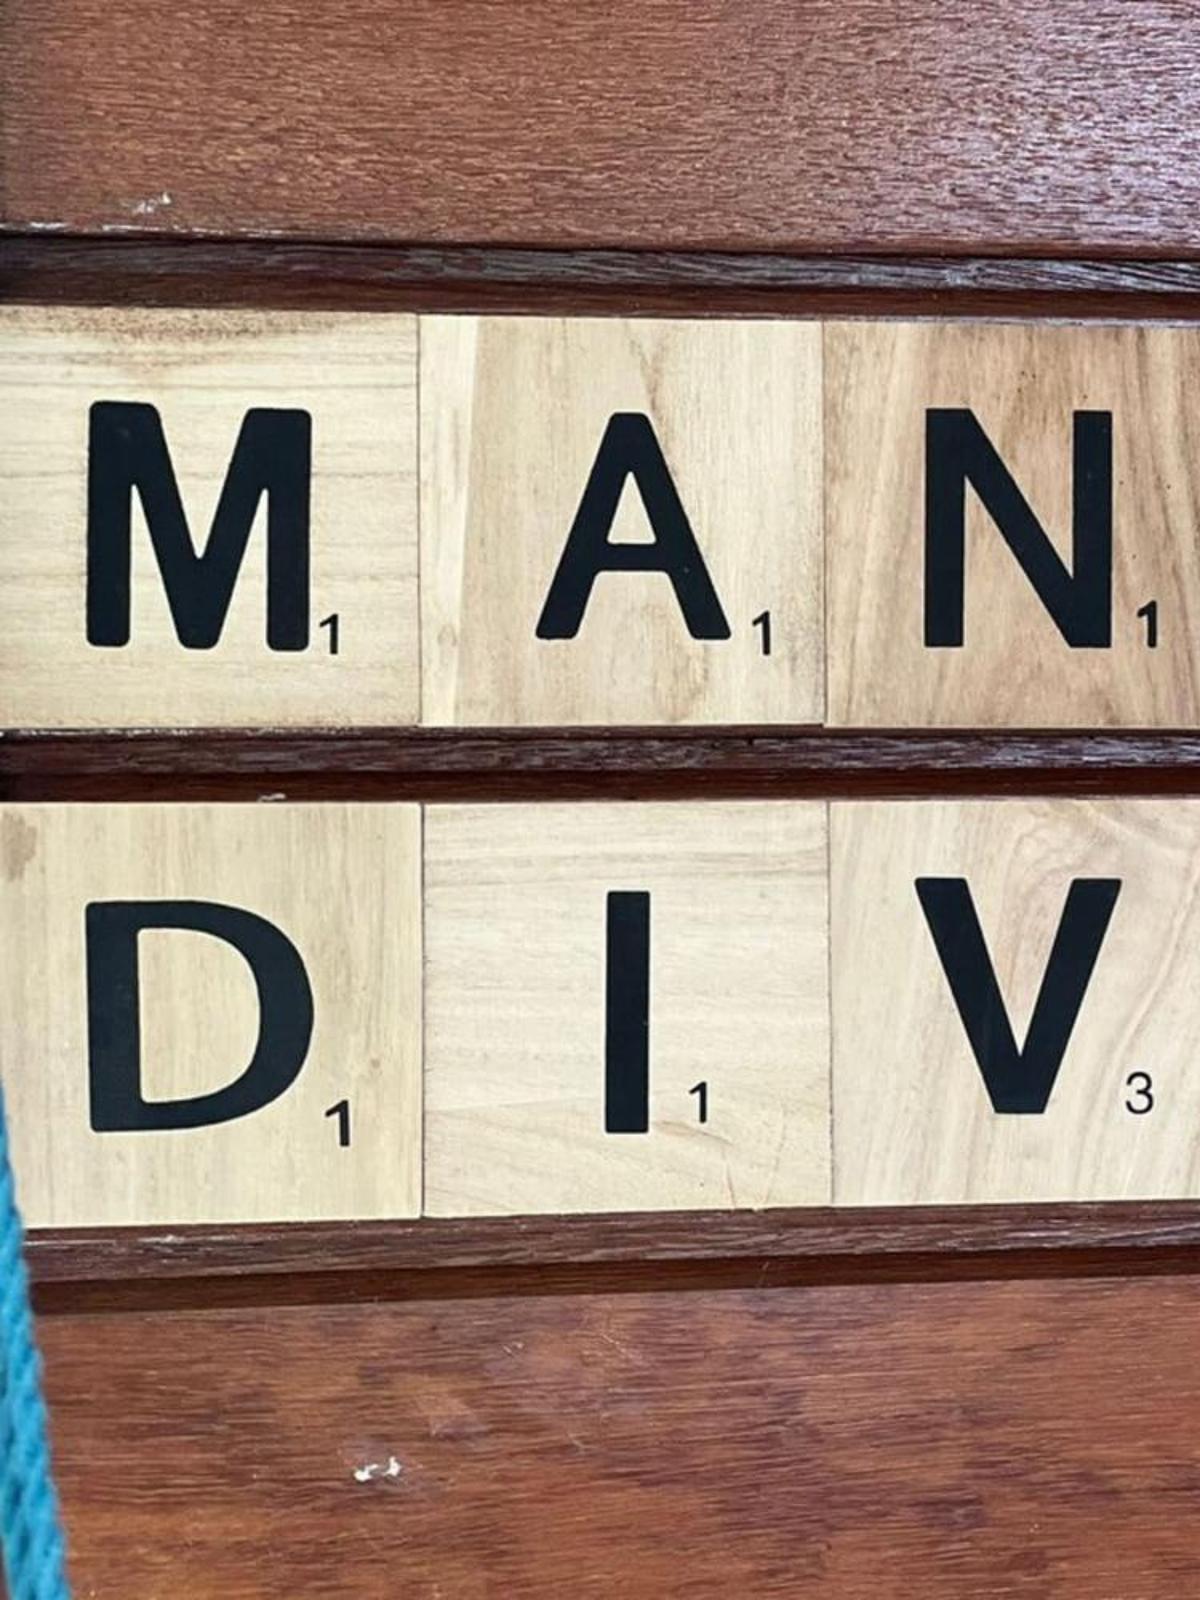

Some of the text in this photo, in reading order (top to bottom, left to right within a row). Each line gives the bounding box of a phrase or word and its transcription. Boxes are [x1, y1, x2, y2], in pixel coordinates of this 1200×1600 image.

[319, 613, 339, 655] 1
[751, 610, 771, 656] 1
[1136, 599, 1159, 650] 1
[689, 1081, 708, 1124] 1
[1125, 1071, 1154, 1115] 3
[324, 1099, 350, 1148] 1
